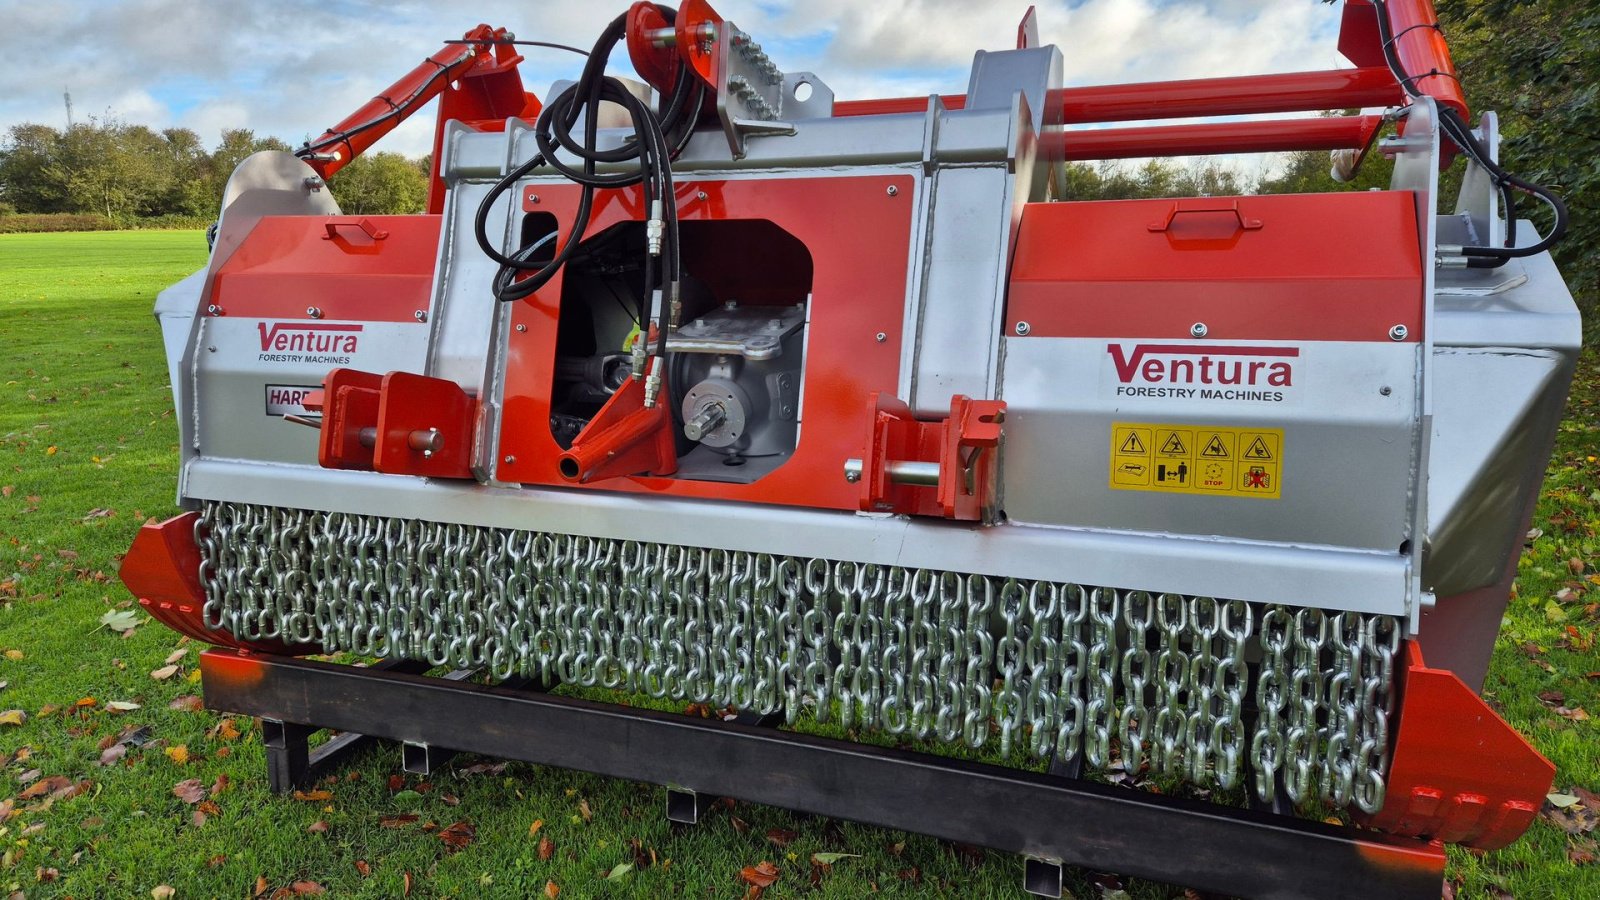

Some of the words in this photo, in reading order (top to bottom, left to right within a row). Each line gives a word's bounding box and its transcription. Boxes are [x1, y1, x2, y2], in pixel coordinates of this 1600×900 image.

[257, 322, 363, 353] Ventura
[259, 354, 303, 363] FORESTRY
[304, 356, 350, 365] MACHINES
[1107, 344, 1299, 386] Ventura
[1117, 386, 1196, 399] FORESTRY
[1200, 389, 1283, 402] MACHINES
